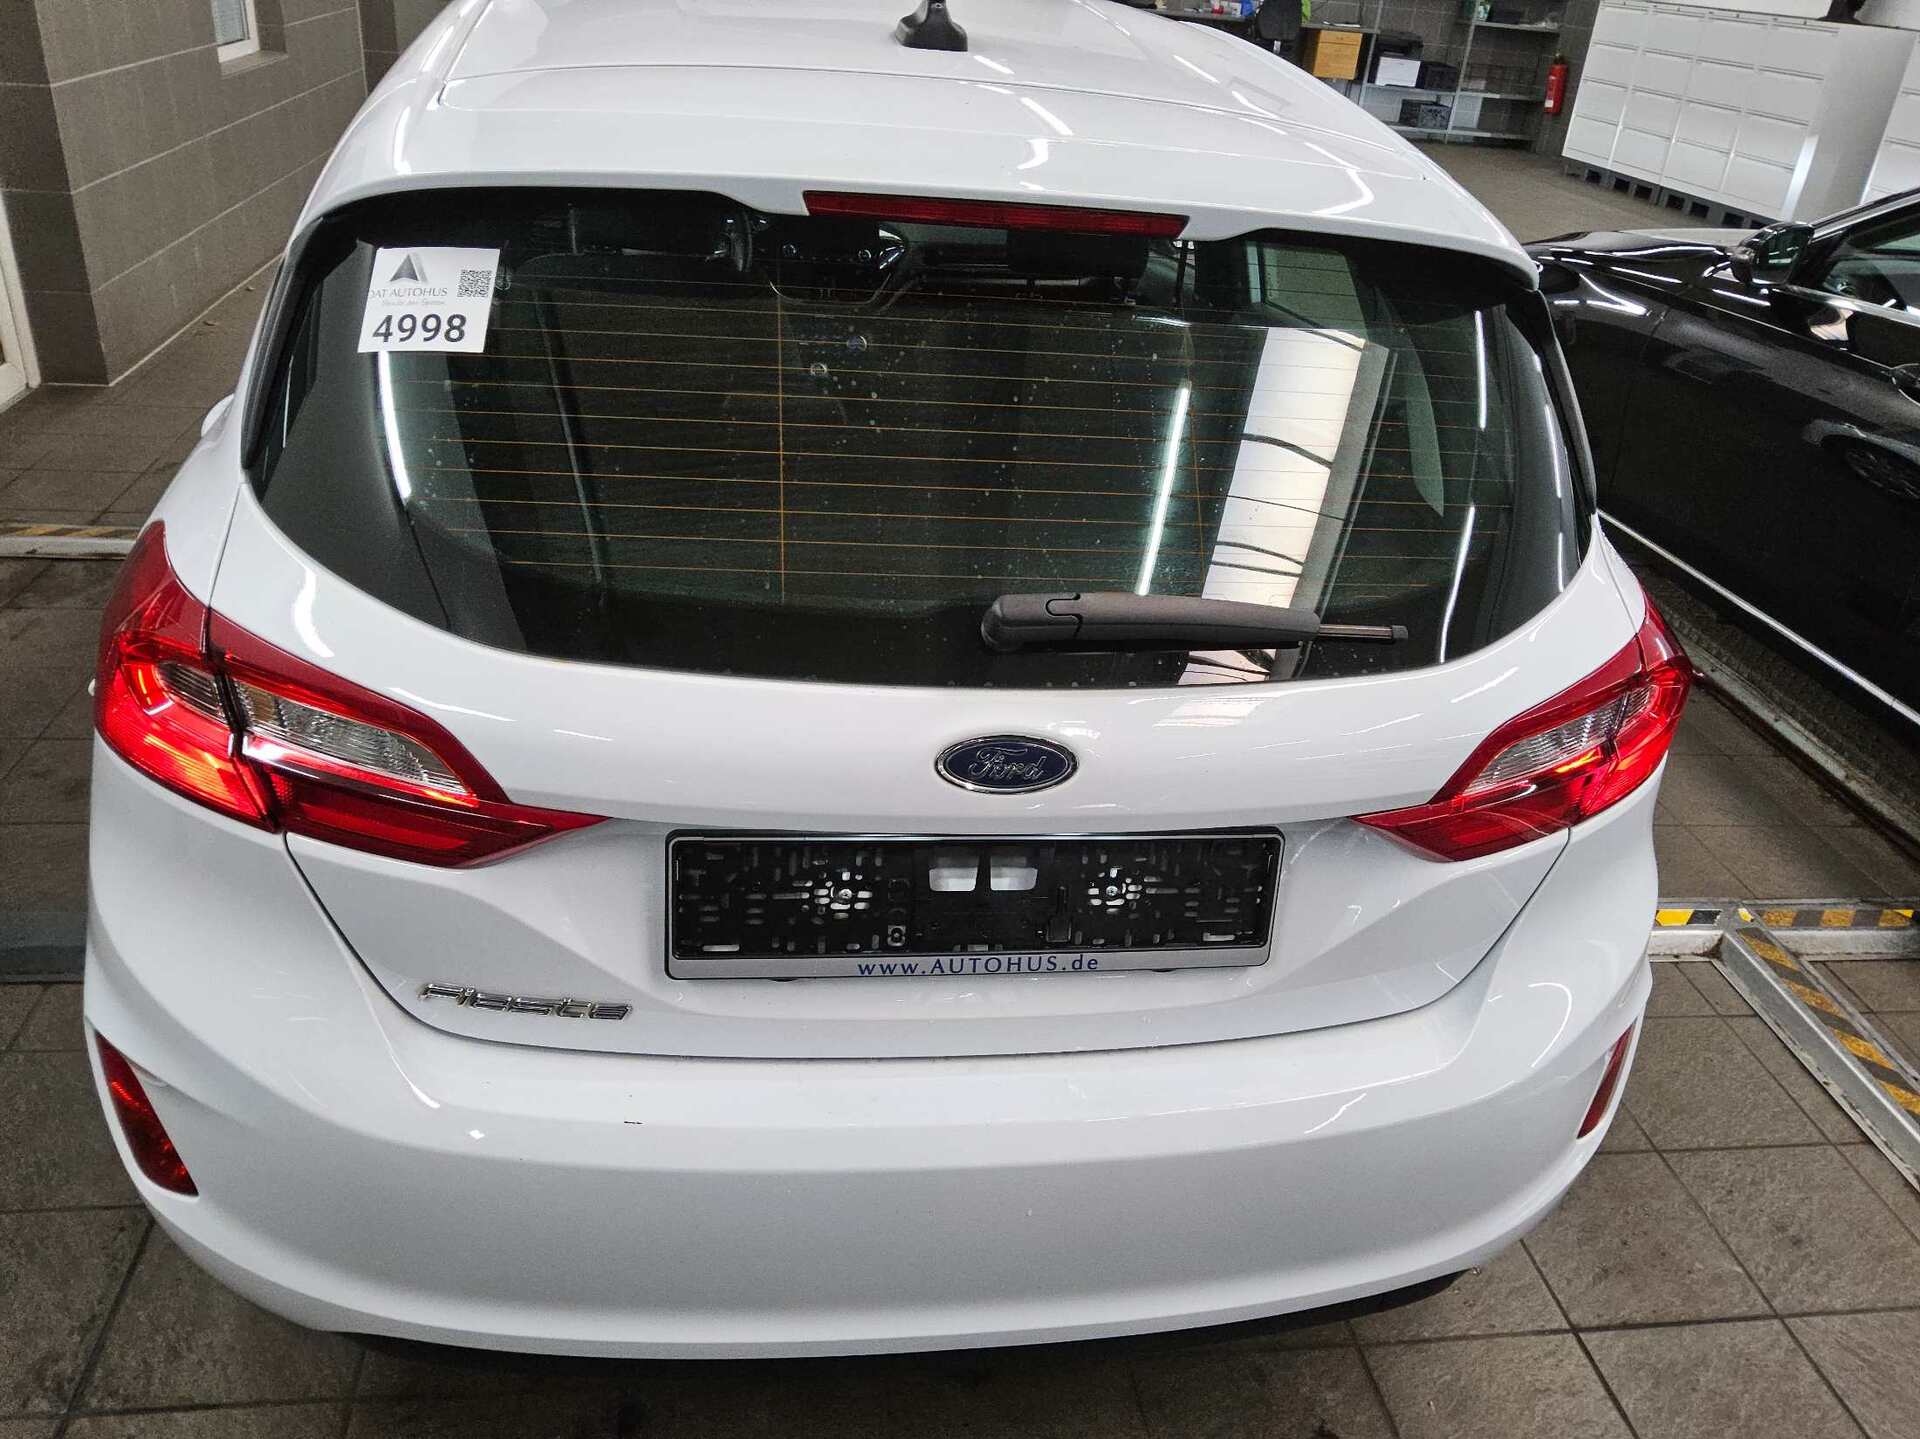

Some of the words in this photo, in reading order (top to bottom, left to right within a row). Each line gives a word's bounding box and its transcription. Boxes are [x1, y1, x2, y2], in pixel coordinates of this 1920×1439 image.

[391, 287, 448, 297] AUTOHUS
[373, 313, 467, 343] 4998
[969, 746, 1047, 782] Ford
[857, 953, 1099, 976] www.AUTOHUS.de
[418, 983, 633, 1021] Fiesta
